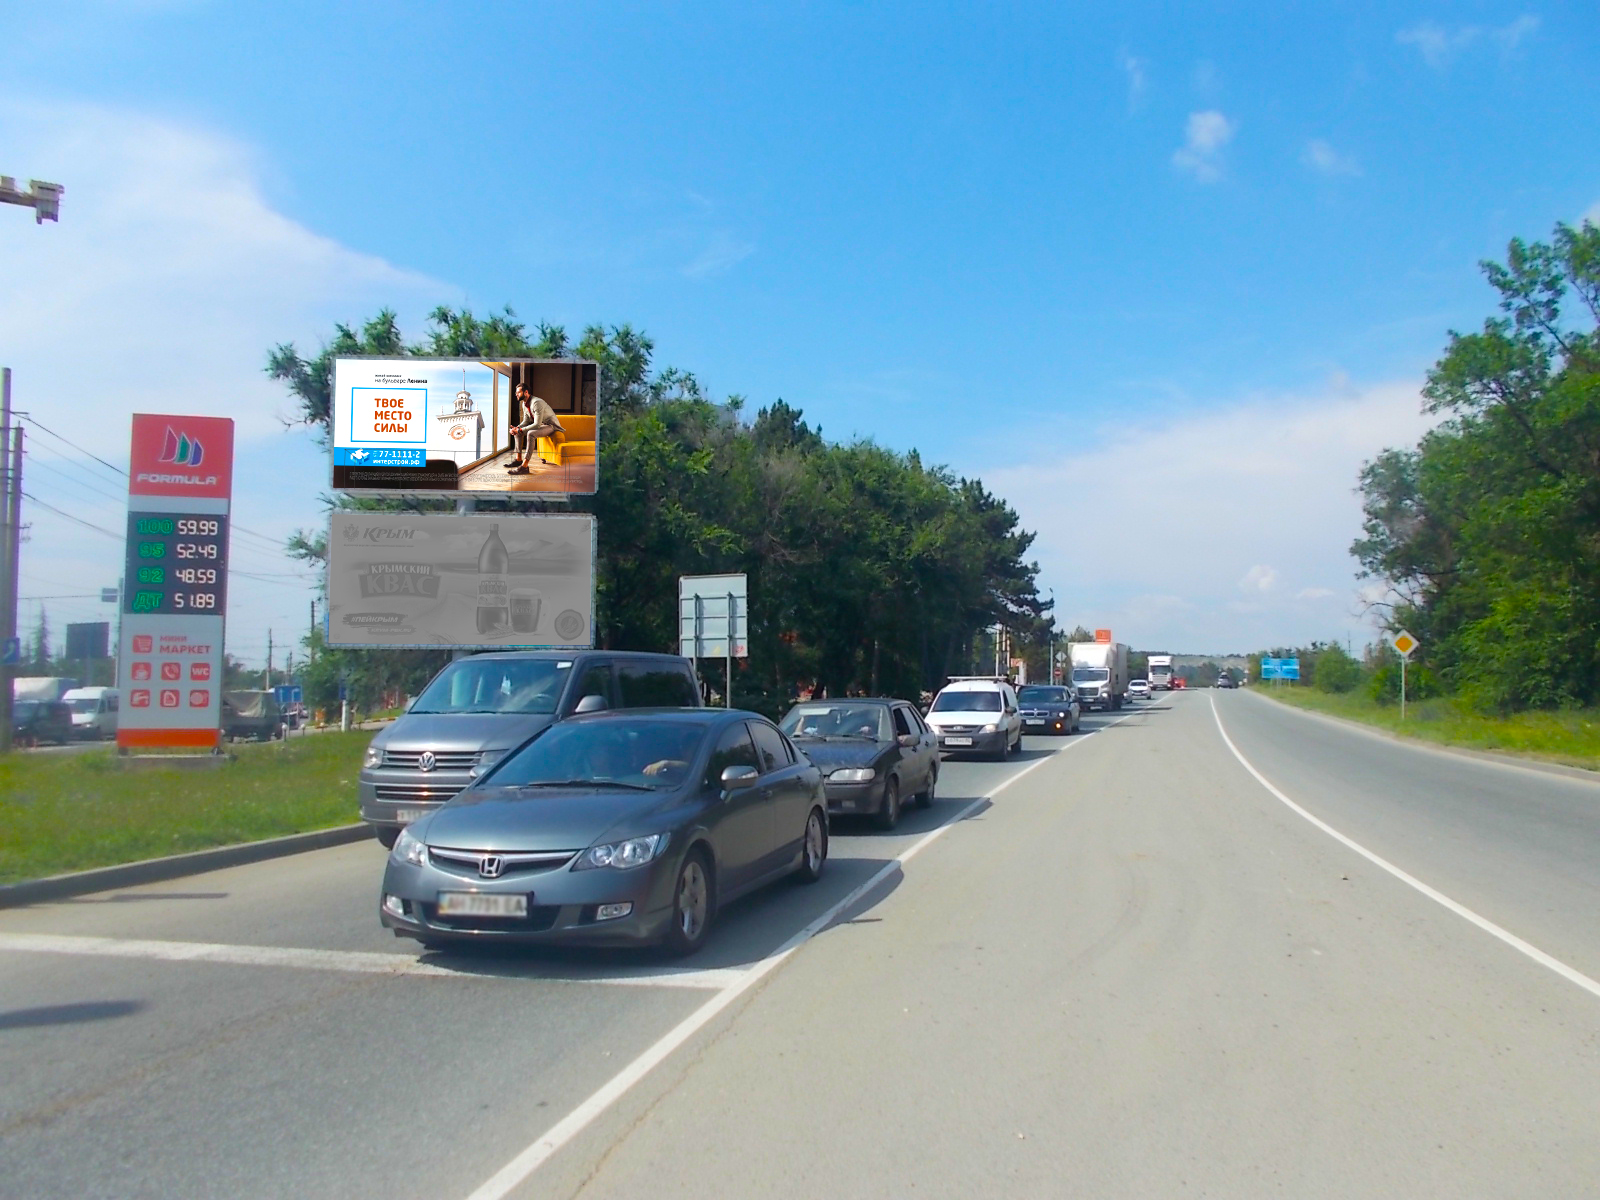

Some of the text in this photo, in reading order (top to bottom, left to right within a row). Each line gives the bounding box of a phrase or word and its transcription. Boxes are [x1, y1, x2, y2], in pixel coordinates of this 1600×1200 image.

[374, 398, 404, 408] ТВОЕ
[374, 410, 412, 420] МЕСТО
[374, 423, 408, 433] СИЛЫ
[137, 473, 217, 485] FORMULA
[138, 518, 218, 535] 100 59.99
[139, 543, 217, 559] 95 52.49
[371, 564, 430, 575] КРЫМСКИЙ
[138, 568, 216, 584] 92 48.59
[367, 574, 433, 594] КВАС
[134, 593, 215, 609] ДТ 51.89
[160, 645, 211, 654] МАРКЕТ
[192, 667, 209, 676] WC
